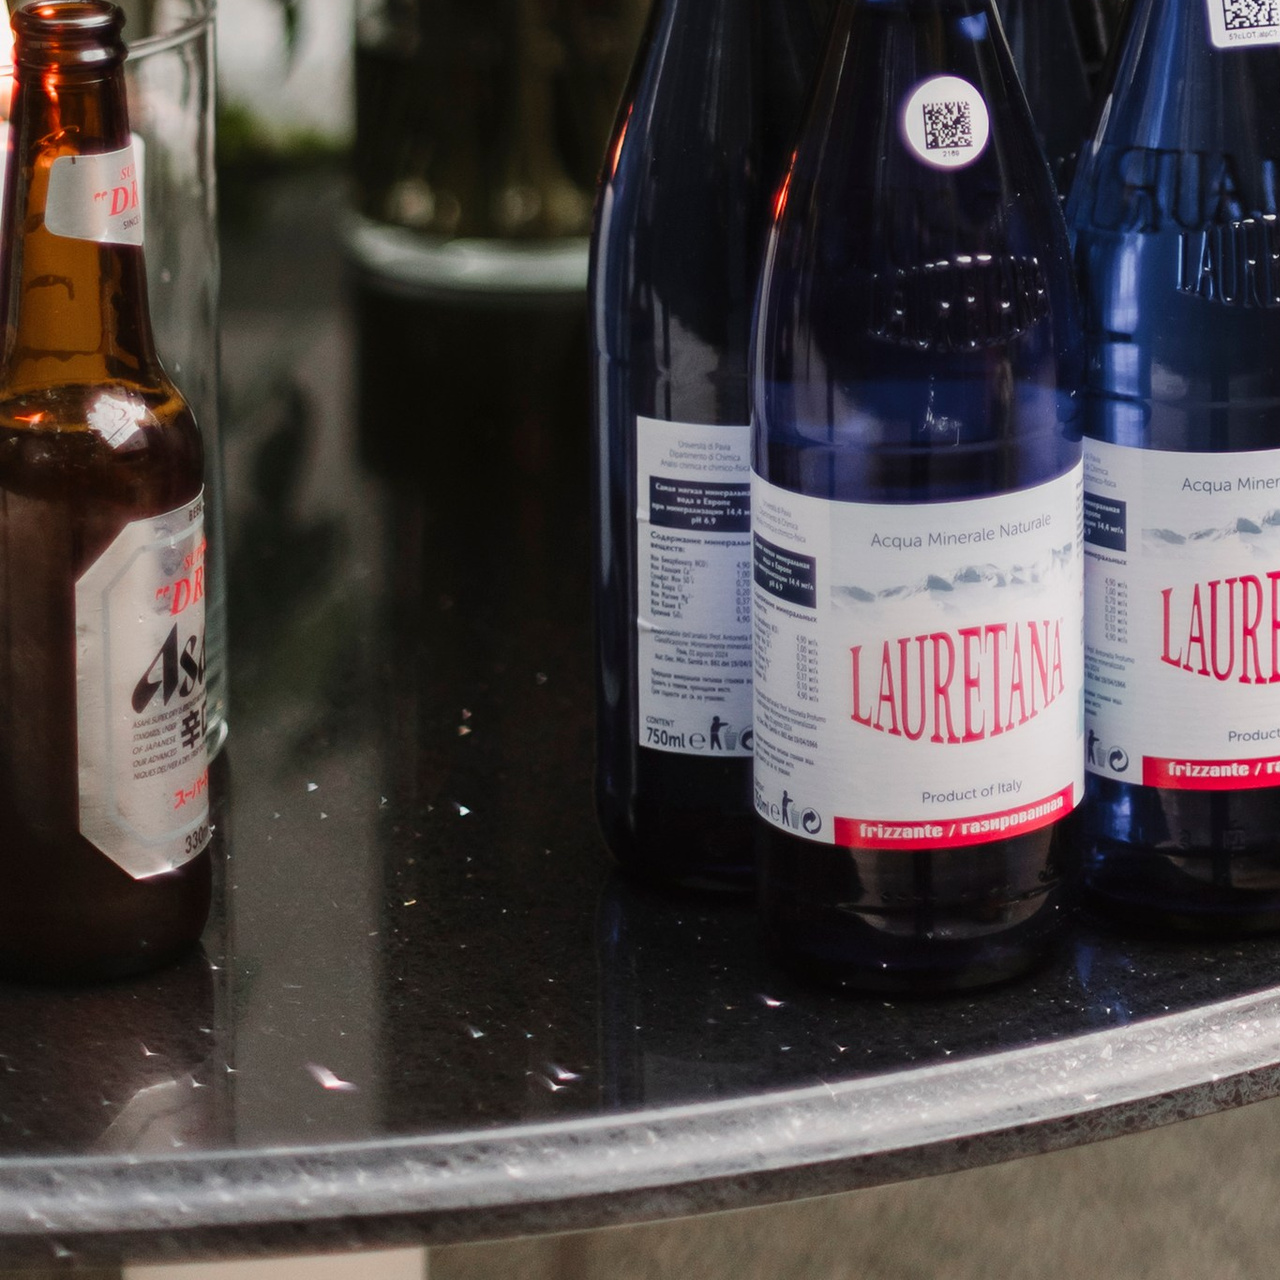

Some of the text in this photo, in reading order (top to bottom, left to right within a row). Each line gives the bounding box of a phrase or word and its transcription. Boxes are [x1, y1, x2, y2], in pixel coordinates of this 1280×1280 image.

[705, 490, 751, 498] минеральна
[1182, 477, 1232, 495] Acqua
[870, 513, 1052, 551] Acqua Minerale Naturale
[850, 619, 1064, 744] LAURETANA
[646, 726, 686, 748] 750ml
[1228, 729, 1280, 742] Product
[1168, 761, 1249, 777] frizzante
[922, 779, 1023, 804] Product of Italy
[859, 823, 943, 839] frizzante
[961, 795, 1064, 836] газированная
